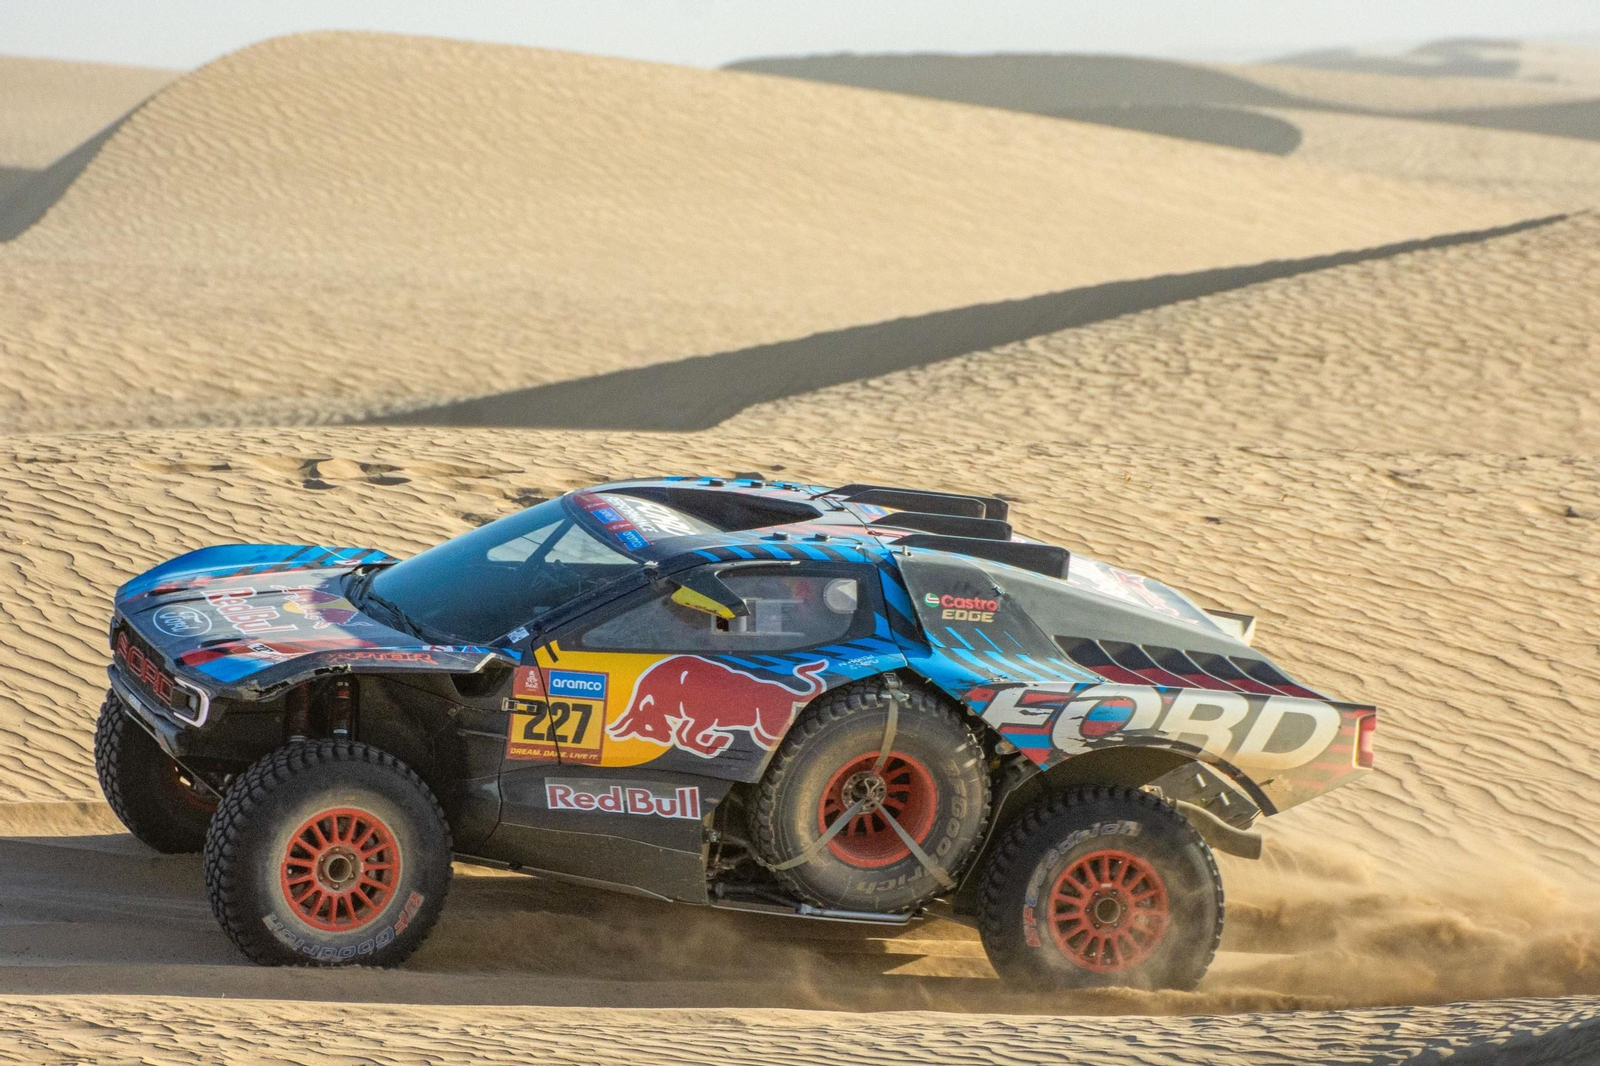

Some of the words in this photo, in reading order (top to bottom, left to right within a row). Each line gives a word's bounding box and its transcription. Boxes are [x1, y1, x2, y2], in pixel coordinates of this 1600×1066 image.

[159, 611, 203, 633] Ford
[941, 609, 995, 623] EDGE
[552, 678, 602, 691] aramco
[523, 701, 593, 744] 227
[982, 683, 1341, 771] FORD
[546, 784, 625, 813] Red
[626, 786, 701, 820] Bull
[856, 757, 967, 895] BFGoorich
[261, 891, 425, 961] BFGoodrich
